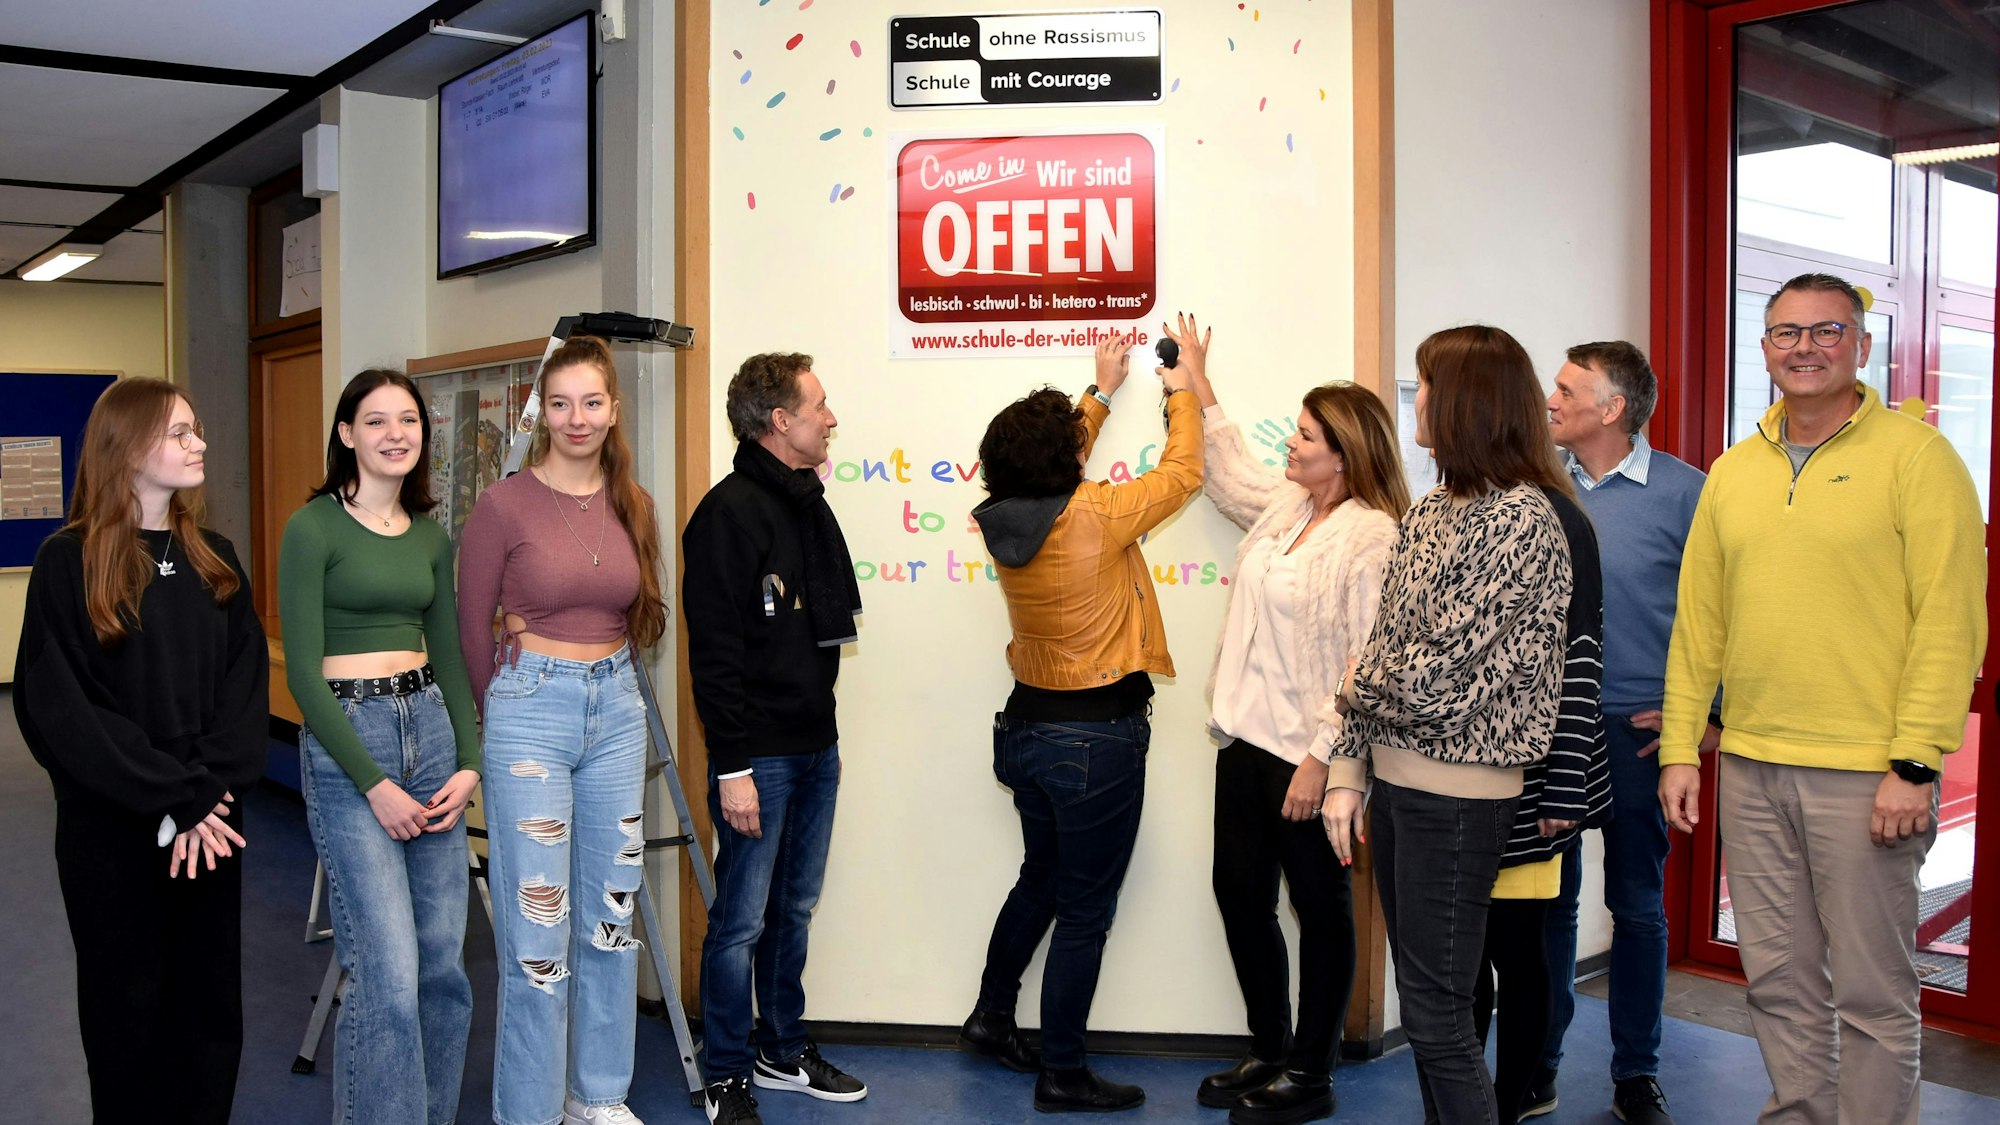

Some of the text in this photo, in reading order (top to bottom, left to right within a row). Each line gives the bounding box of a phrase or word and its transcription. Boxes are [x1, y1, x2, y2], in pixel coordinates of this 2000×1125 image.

[905, 28, 1146, 49] Schule ohne Rassismus
[906, 71, 1111, 91] Schule mit Courage
[920, 154, 1025, 190] Come in
[1036, 156, 1132, 187] Wir sind
[922, 197, 1134, 277] OFFEN
[910, 296, 963, 312] lesbisch
[973, 294, 1019, 310] schwul
[1029, 294, 1042, 309] bi
[1052, 293, 1096, 309] hetero
[903, 500, 945, 533] to
[854, 549, 1229, 586] our tru urs.
